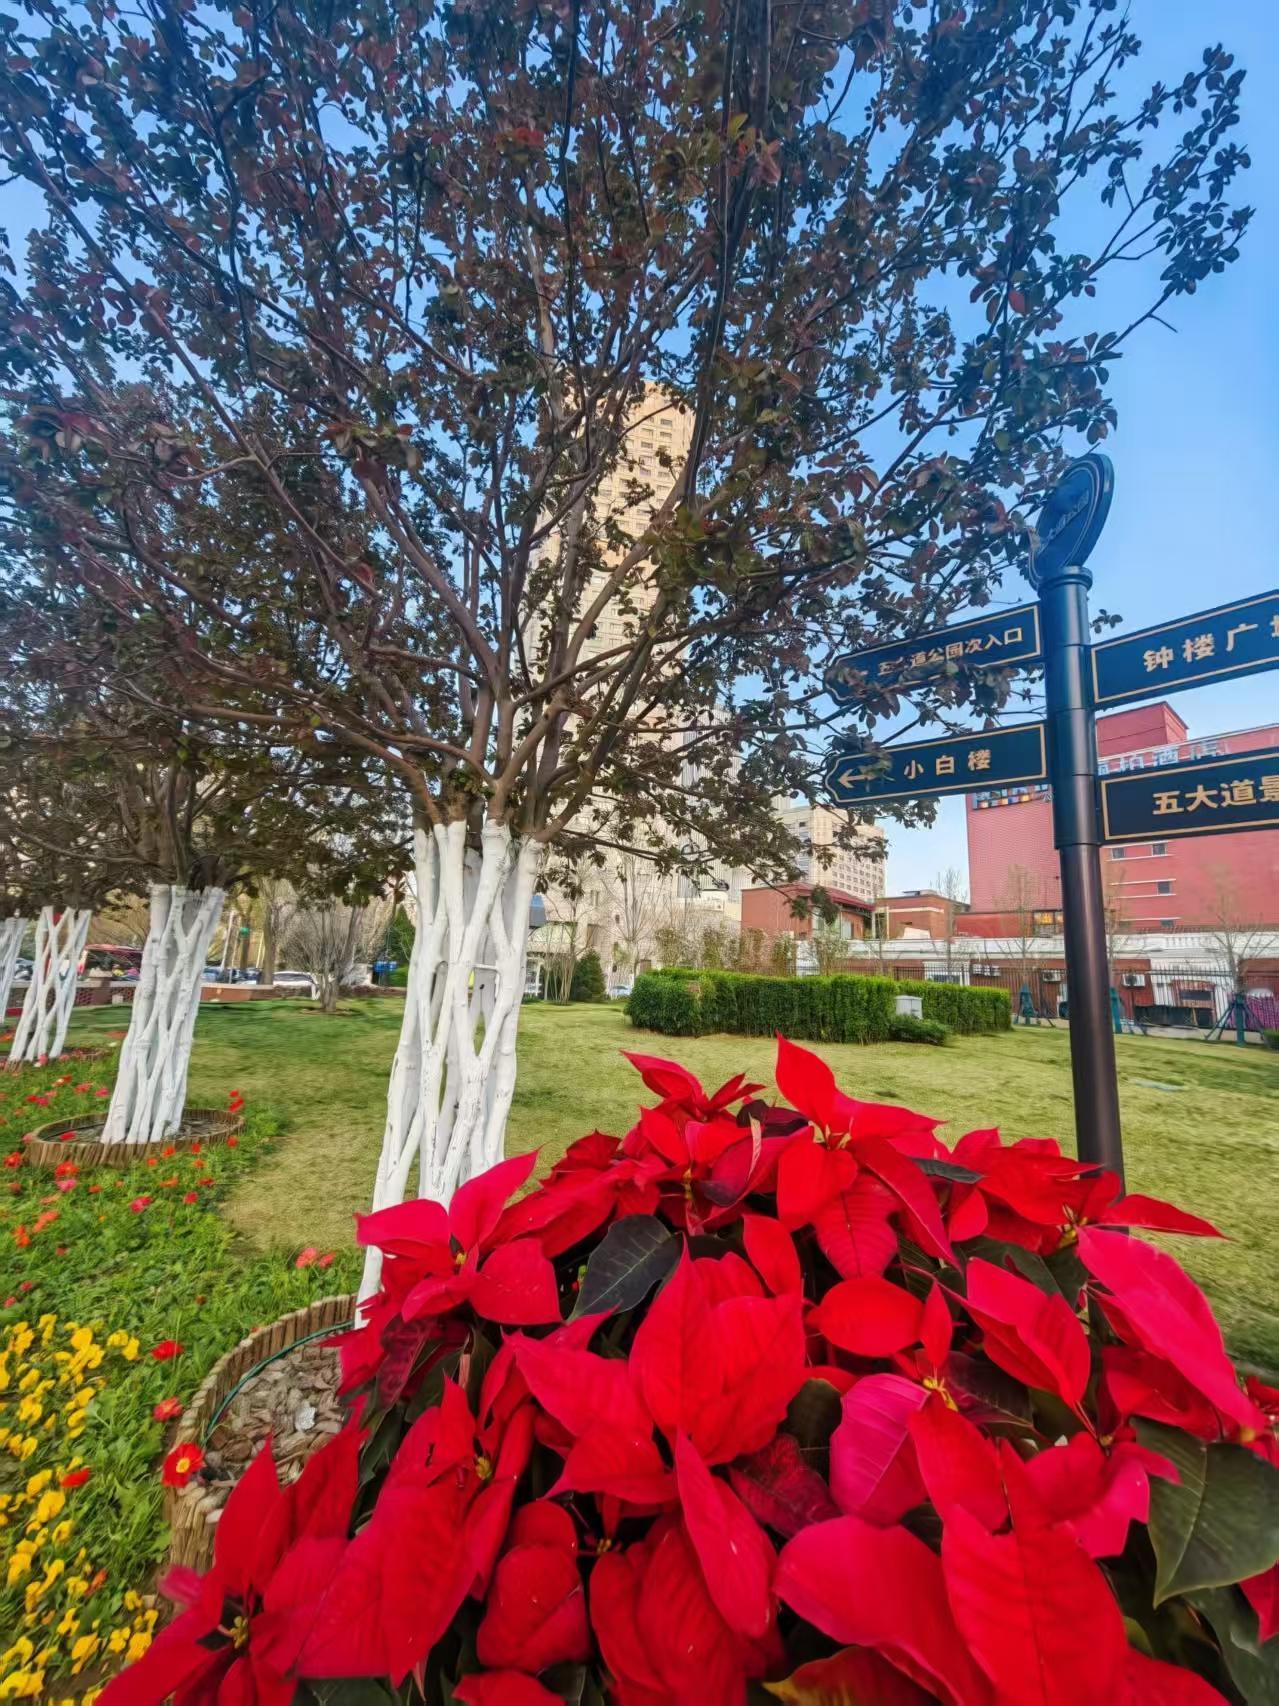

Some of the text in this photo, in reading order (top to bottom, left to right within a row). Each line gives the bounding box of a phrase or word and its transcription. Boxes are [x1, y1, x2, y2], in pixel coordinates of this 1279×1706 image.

[879, 627, 1022, 676] 五道公园次入口
[903, 749, 991, 780] 小白楼
